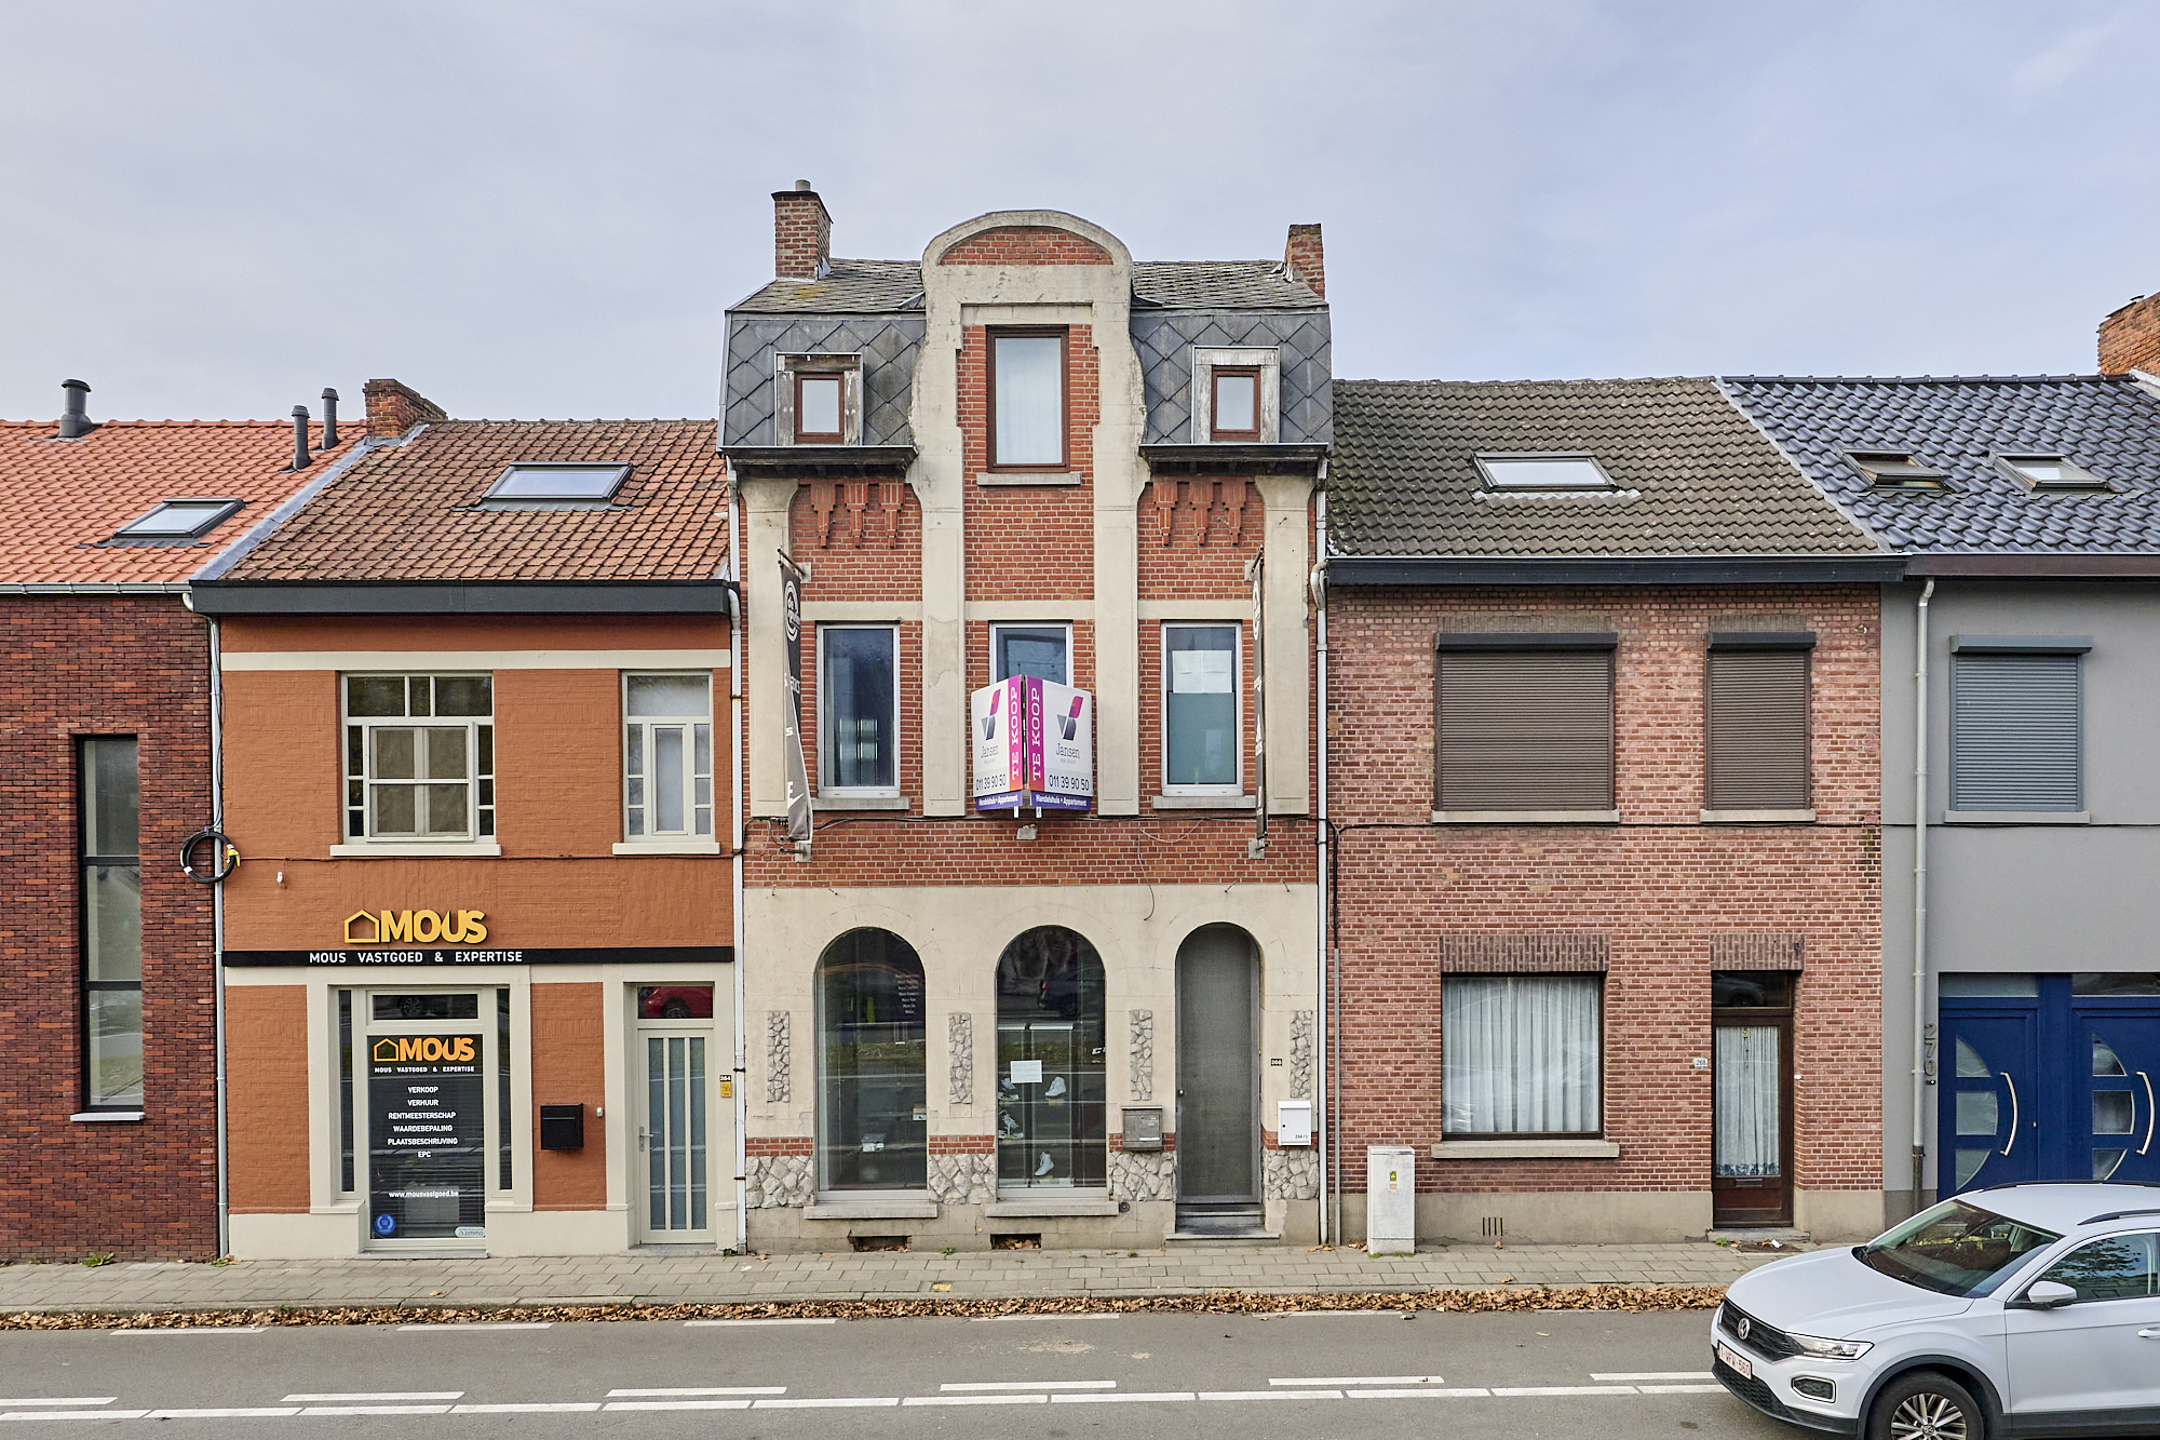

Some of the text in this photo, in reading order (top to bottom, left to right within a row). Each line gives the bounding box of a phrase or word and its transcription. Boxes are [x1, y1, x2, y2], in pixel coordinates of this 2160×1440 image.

[1010, 686, 1019, 781] TE KOOP
[1031, 687, 1041, 781] TE KOOP
[1055, 742, 1080, 759] Jansen
[984, 776, 990, 790] 39
[991, 775, 998, 788] 90
[1049, 774, 1090, 791] 011 39 90 50
[381, 909, 488, 944] MOUS
[309, 951, 523, 963] MOUS VASTGOED & EXPERTISE
[399, 1036, 476, 1062] MOUS
[388, 1190, 459, 1198] www.mousvastgoed.be
